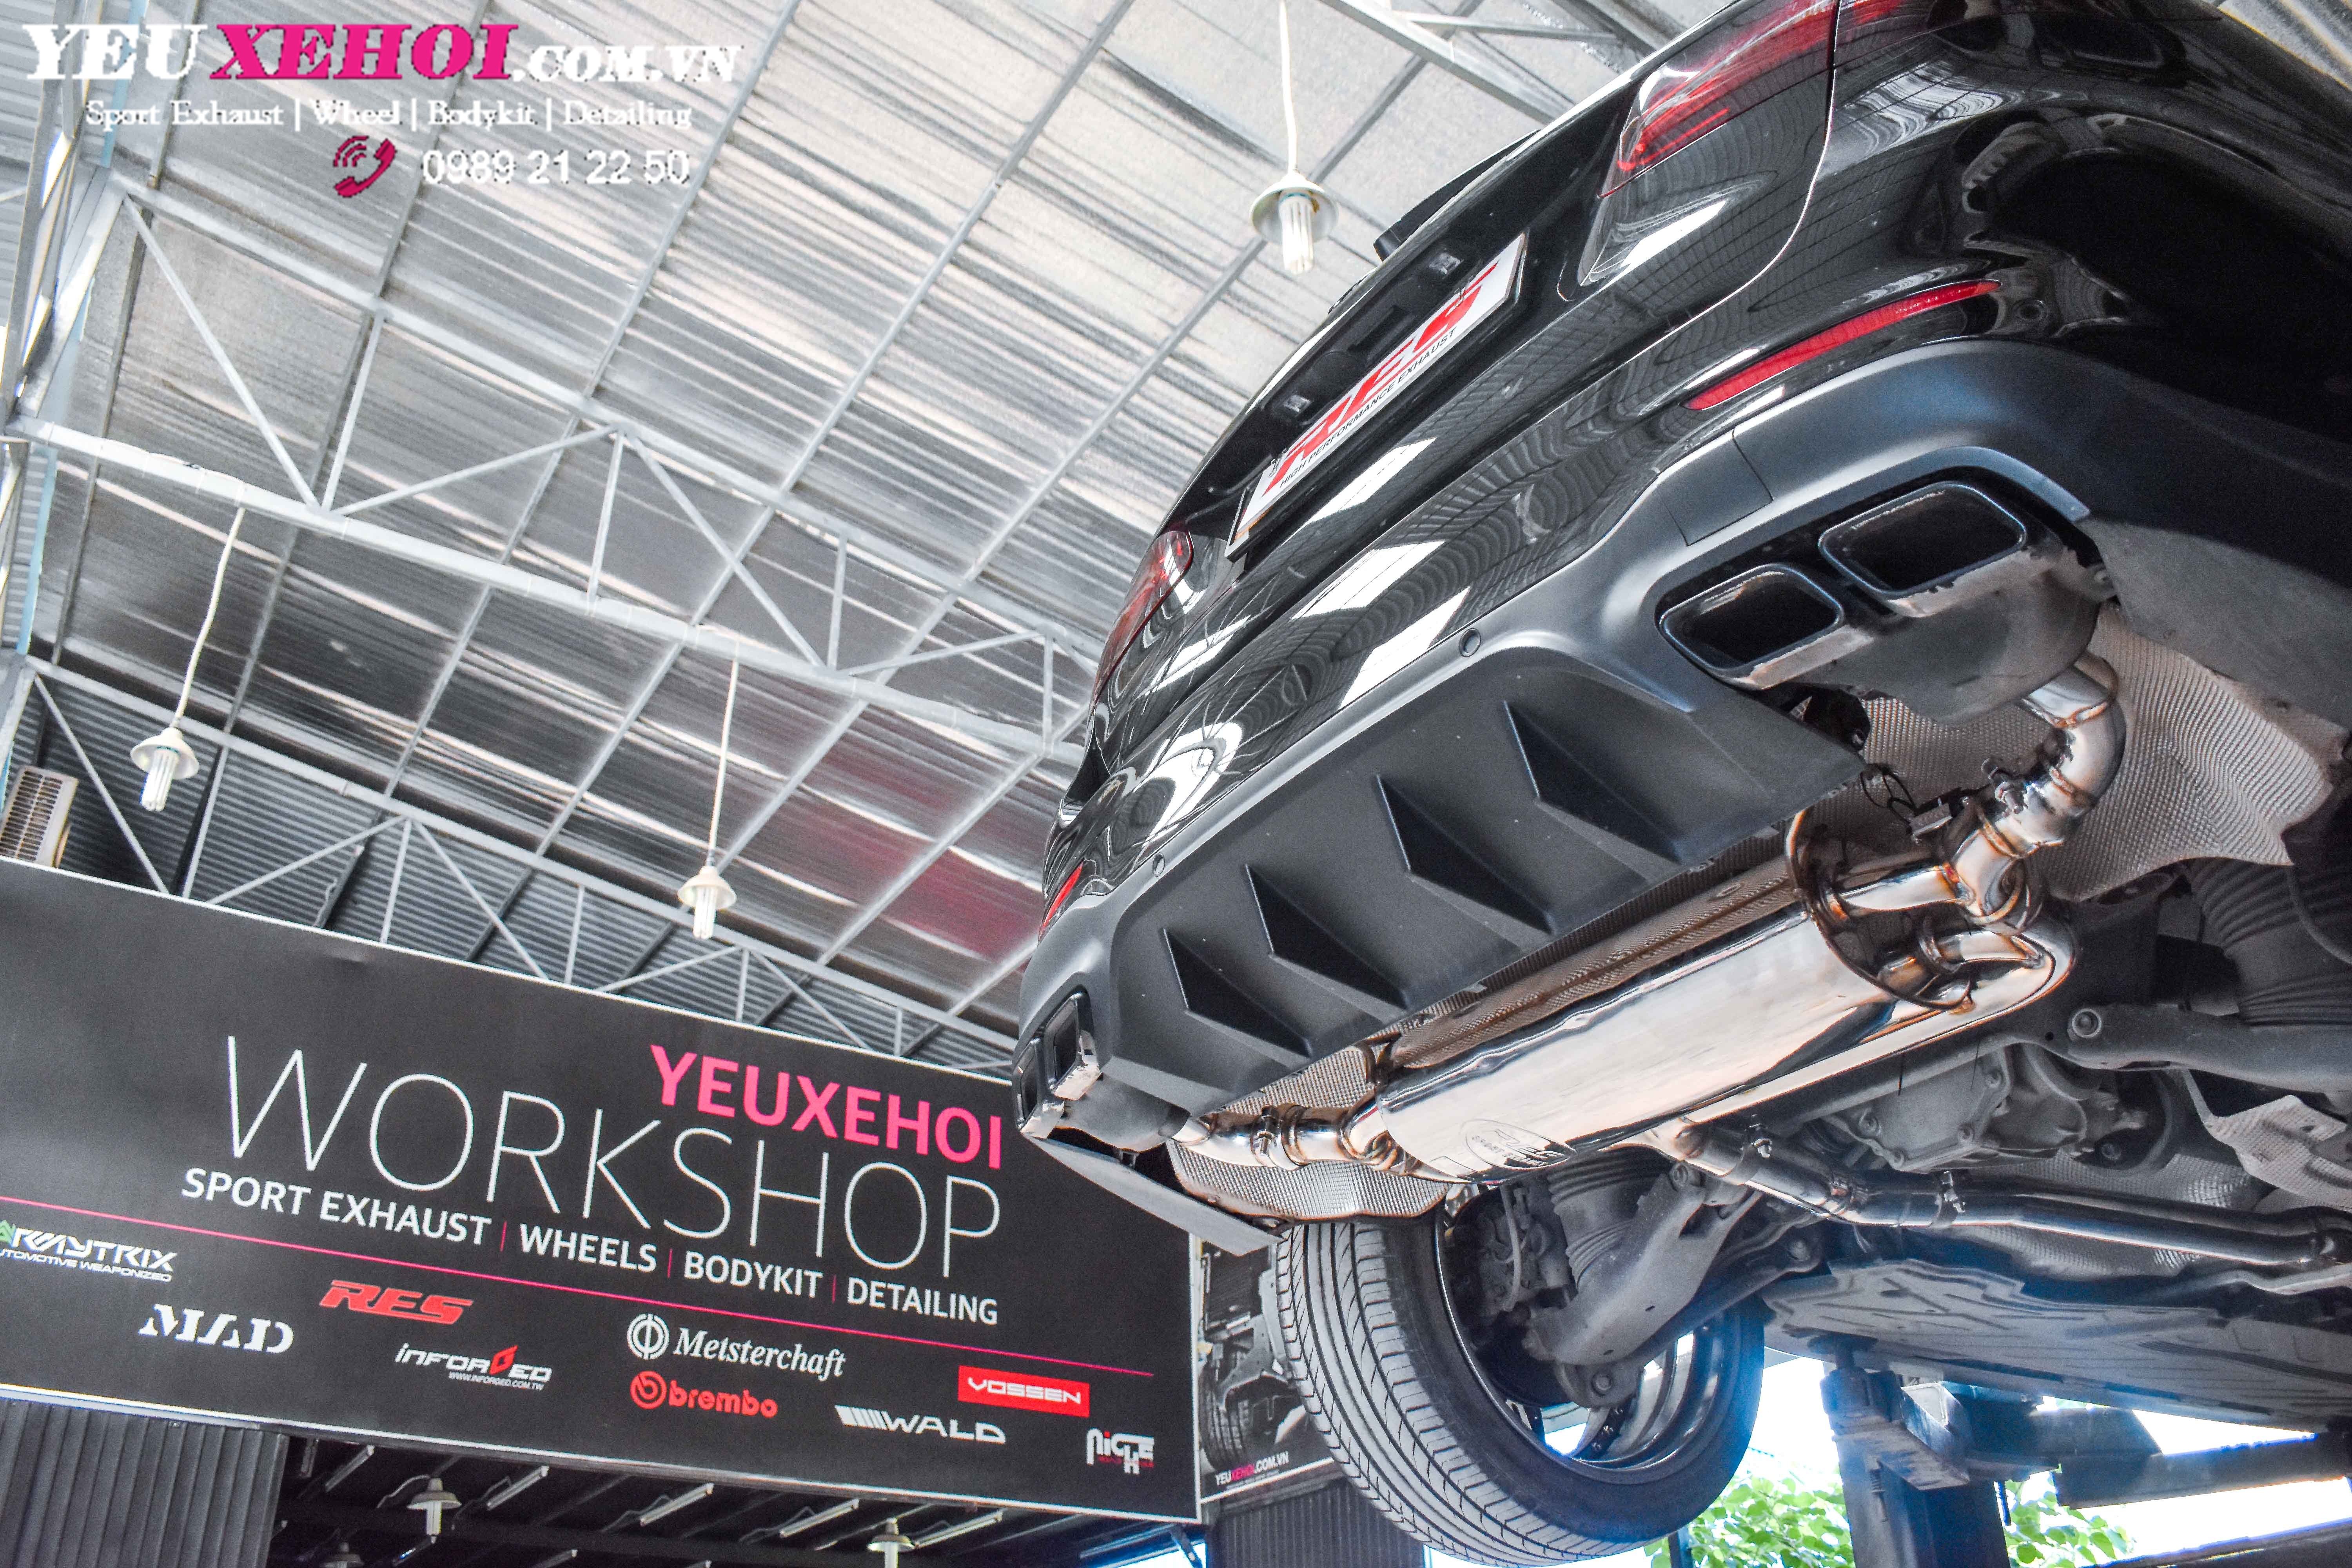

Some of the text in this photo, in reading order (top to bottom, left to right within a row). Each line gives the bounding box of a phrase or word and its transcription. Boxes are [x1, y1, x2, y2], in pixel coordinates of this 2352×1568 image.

[1279, 326, 1457, 488] HIGH PERFORMANCE EXHAUST
[650, 1044, 1002, 1170] YEUXEHOI
[227, 1034, 1000, 1278] WORKSHOP
[79, 1260, 172, 1283] WEAPONIZED
[181, 1167, 998, 1326] SPORT EXHAUST WHEELS BODYKIT DETAILING
[319, 1279, 474, 1325] RES
[138, 1303, 294, 1354] MAD
[672, 1327, 847, 1382] Meisterchaft
[668, 1379, 779, 1419] brembo
[967, 1376, 1082, 1405] VOSSEN
[881, 1411, 1006, 1445] WALD
